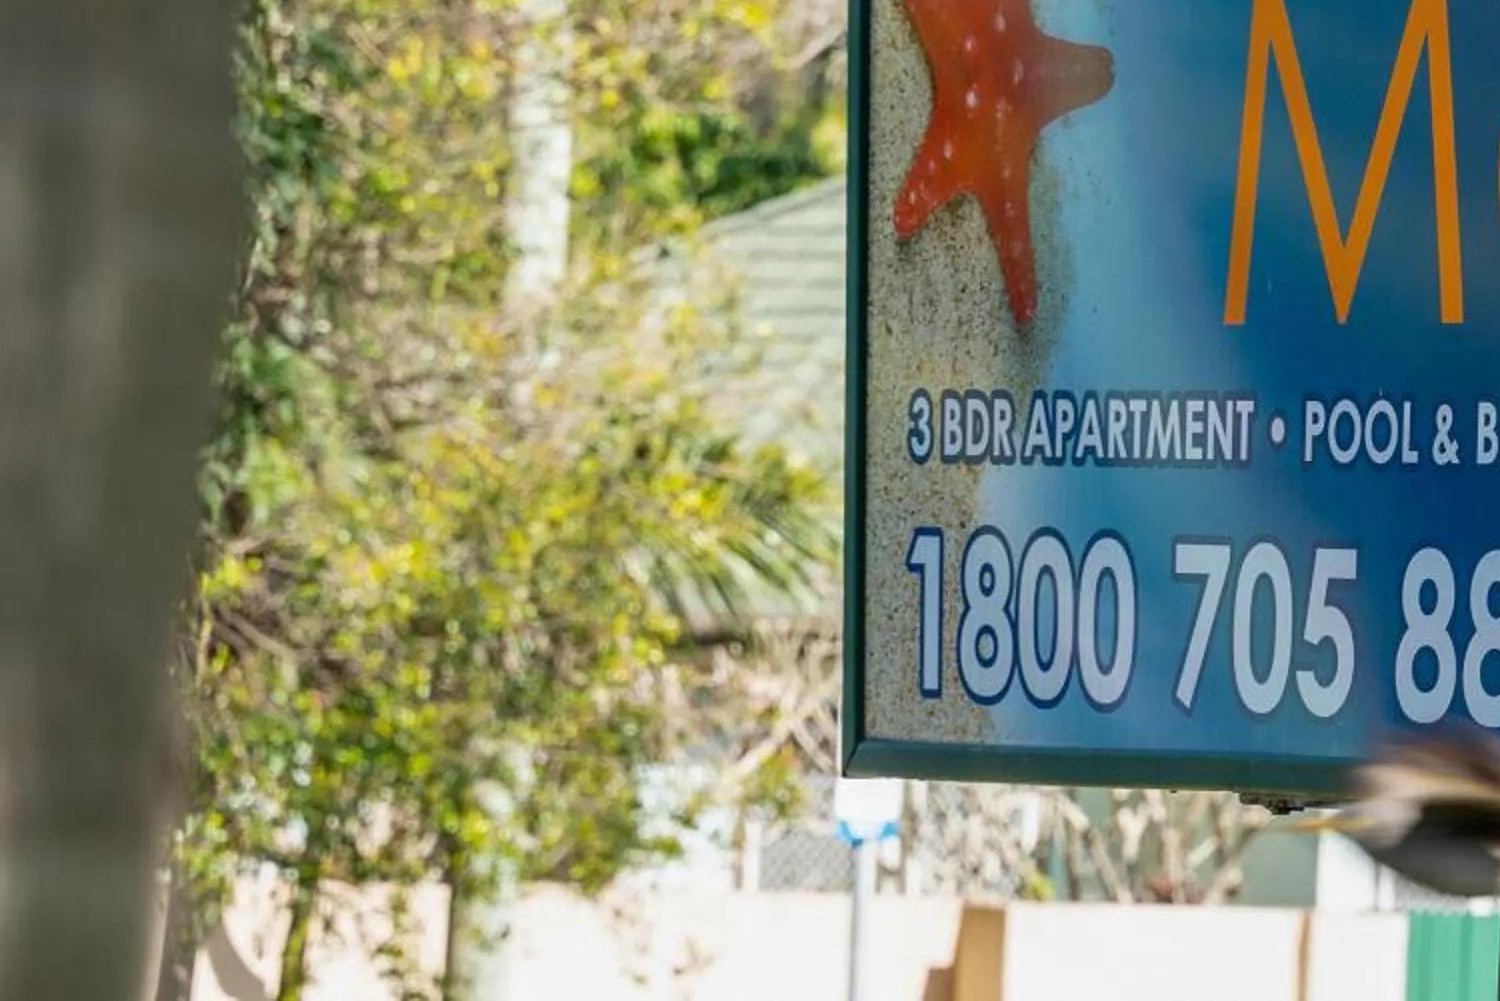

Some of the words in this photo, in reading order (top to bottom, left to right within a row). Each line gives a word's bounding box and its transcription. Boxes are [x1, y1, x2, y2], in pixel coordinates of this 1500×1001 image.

[908, 396, 933, 465] 3
[943, 397, 1014, 462] BDR
[1023, 399, 1255, 463] APARTMENT
[1303, 400, 1418, 465] POOL
[1431, 404, 1461, 465] &
[907, 529, 1135, 708] 1800
[1174, 541, 1359, 719] 705
